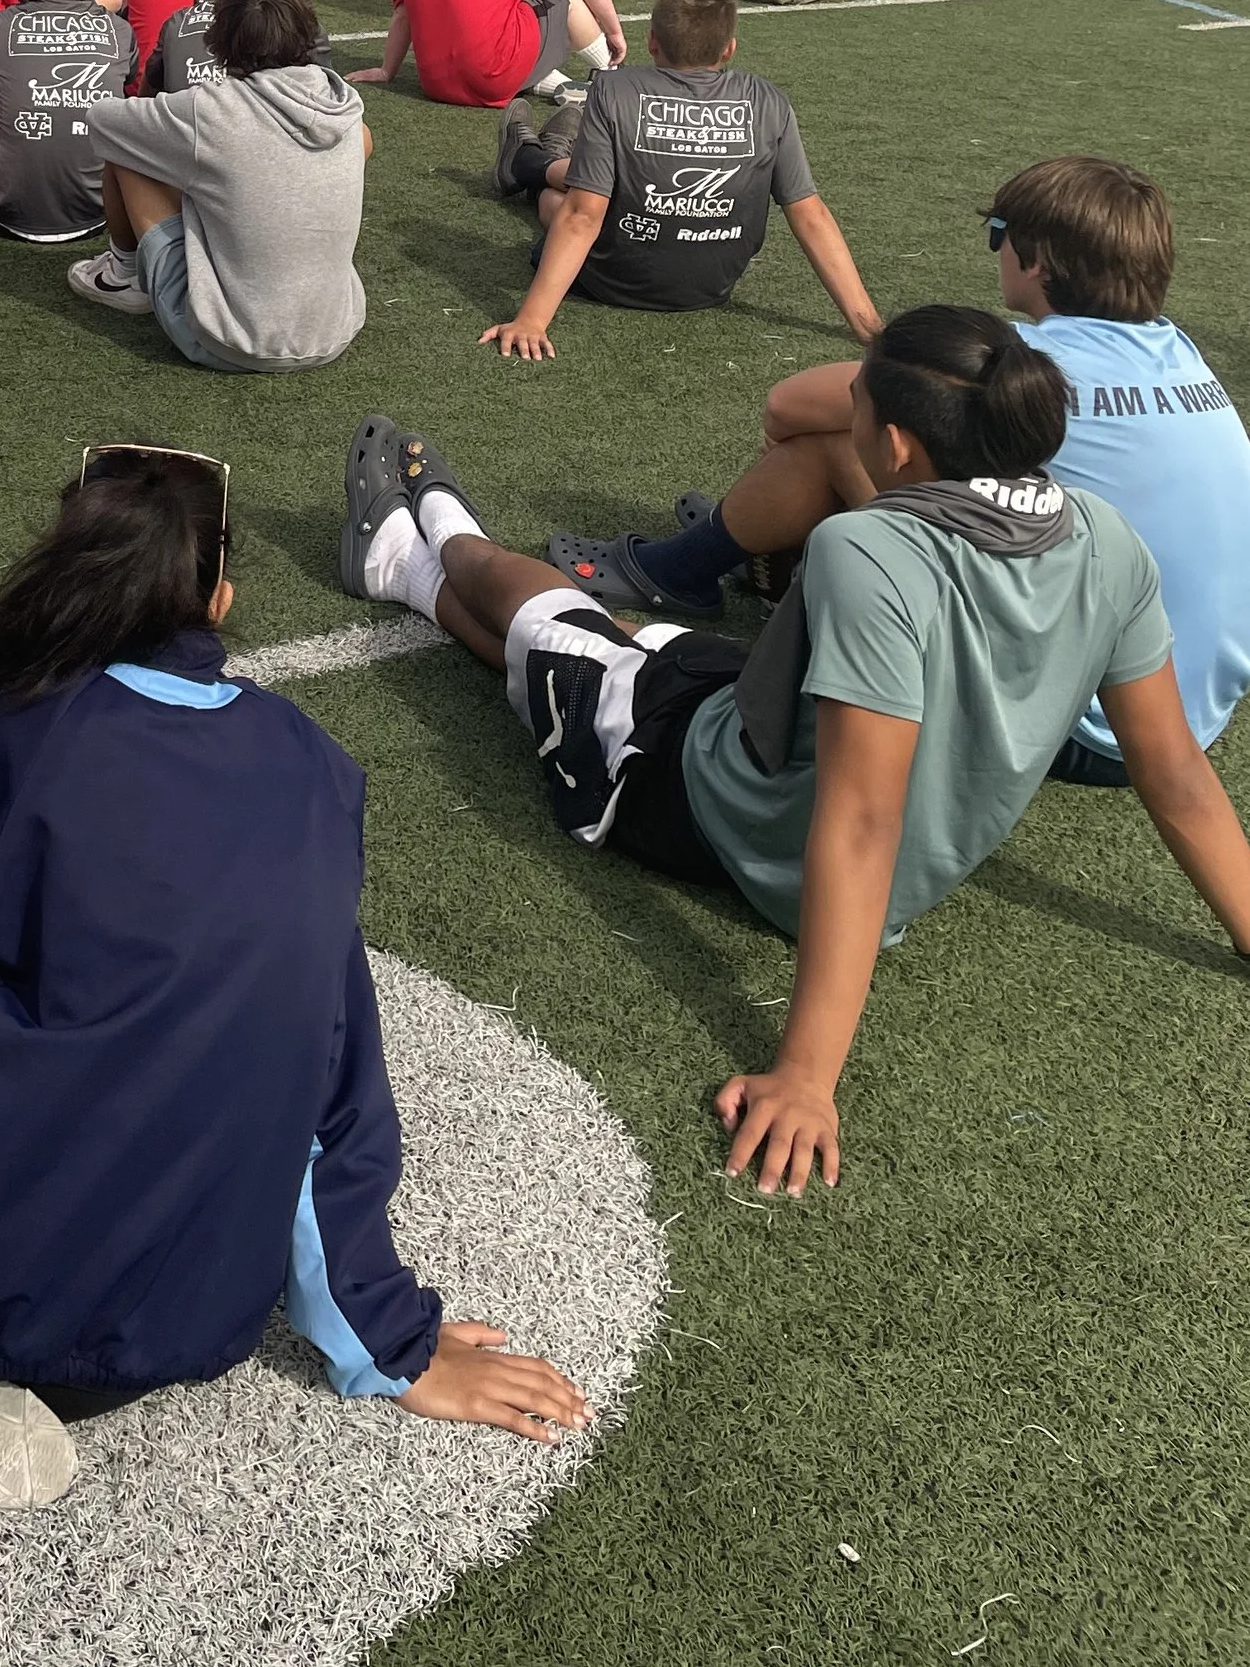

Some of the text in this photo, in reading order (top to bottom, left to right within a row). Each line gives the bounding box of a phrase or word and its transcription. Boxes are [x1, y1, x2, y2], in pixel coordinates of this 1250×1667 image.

[18, 15, 108, 33] CHICAGO
[17, 34, 65, 44] STEAK
[80, 34, 109, 45] FISH
[43, 44, 97, 53] LOS GATOS
[34, 100, 61, 108] FAMILY
[647, 101, 746, 127] CHICAGO
[646, 126, 698, 141] STEAK
[712, 130, 746, 141] FISH
[671, 142, 728, 154] LOS GATOS
[644, 195, 735, 212] MARIUCCI
[645, 206, 730, 218] FAMILY FOUNDATION
[676, 225, 743, 242] Riddell
[1092, 386, 1148, 417] AM
[1152, 386, 1175, 414] A
[1170, 380, 1232, 414] WARR
